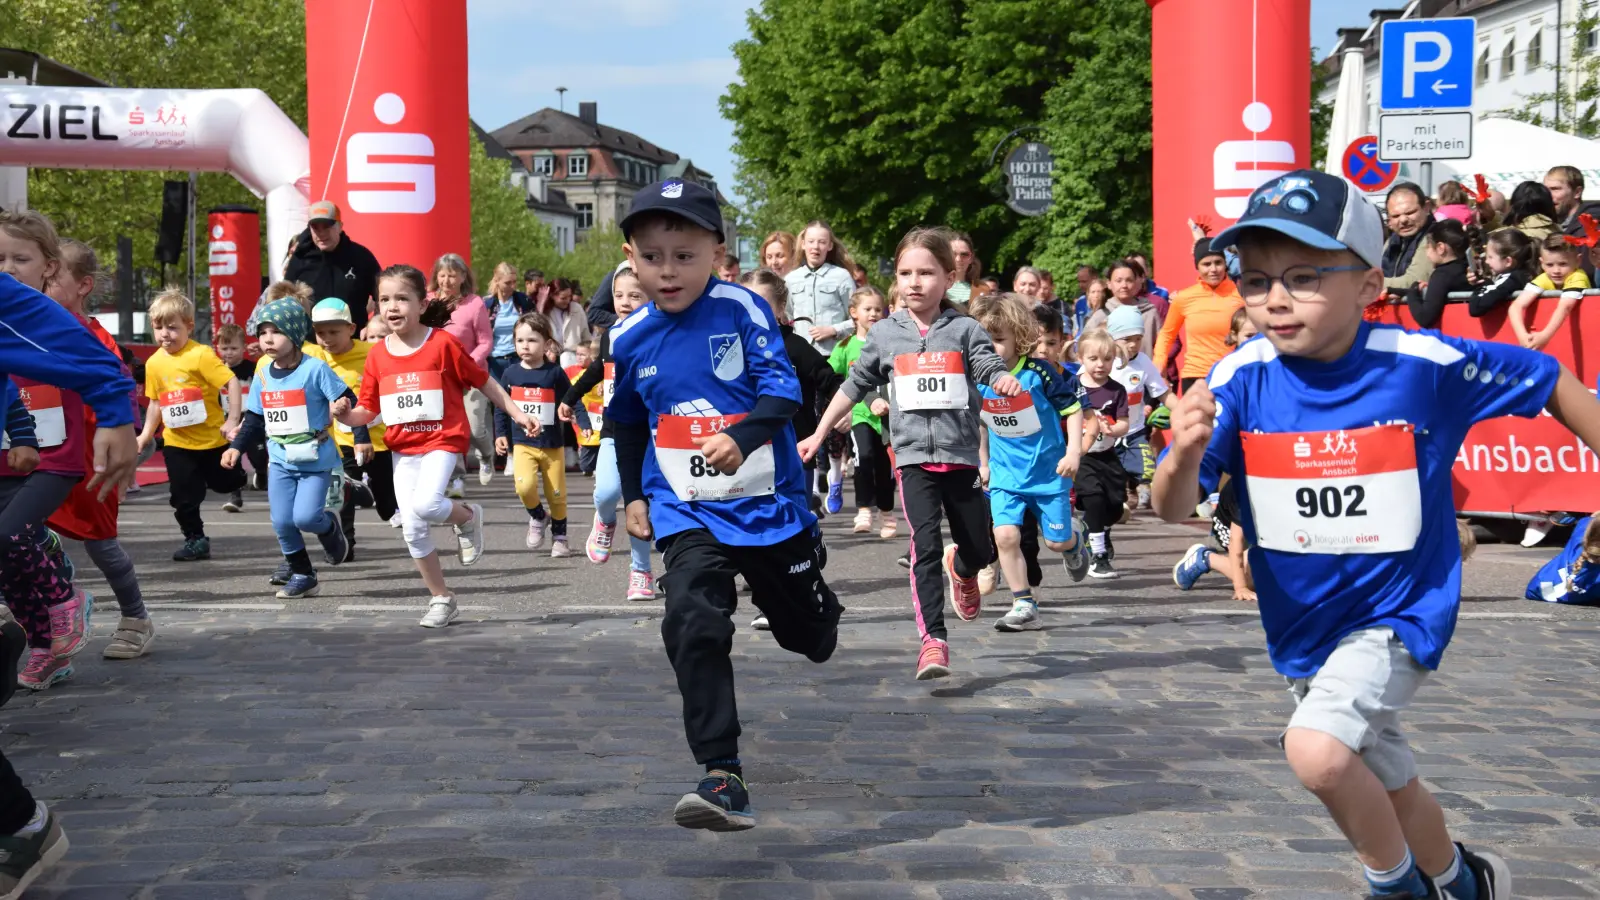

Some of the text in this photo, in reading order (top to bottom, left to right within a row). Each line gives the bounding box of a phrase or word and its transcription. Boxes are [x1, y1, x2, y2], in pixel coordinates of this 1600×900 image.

[1402, 31, 1452, 98] P
[7, 103, 118, 140] ZIEL
[1414, 124, 1437, 135] mit
[1386, 138, 1465, 151] Parkschein
[1010, 161, 1053, 174] HOTEL
[1012, 174, 1053, 189] Bürger
[1015, 187, 1052, 200] Palais
[714, 338, 731, 360] TSV
[638, 365, 658, 379] JAKO
[917, 377, 947, 392] 801
[397, 394, 423, 409] 884
[170, 405, 189, 417] 838
[523, 404, 541, 414] 921
[267, 410, 288, 423] 920
[993, 415, 1018, 427] 866
[402, 422, 443, 433] Ansbach
[1451, 435, 1600, 473] Ansbach
[1138, 443, 1156, 479] TEAM
[1295, 457, 1357, 469] Sparkassenlauf
[1322, 467, 1357, 476] Ansbach
[1295, 485, 1368, 518] 902
[1356, 532, 1380, 542] eisen
[788, 559, 811, 574] JAKO
